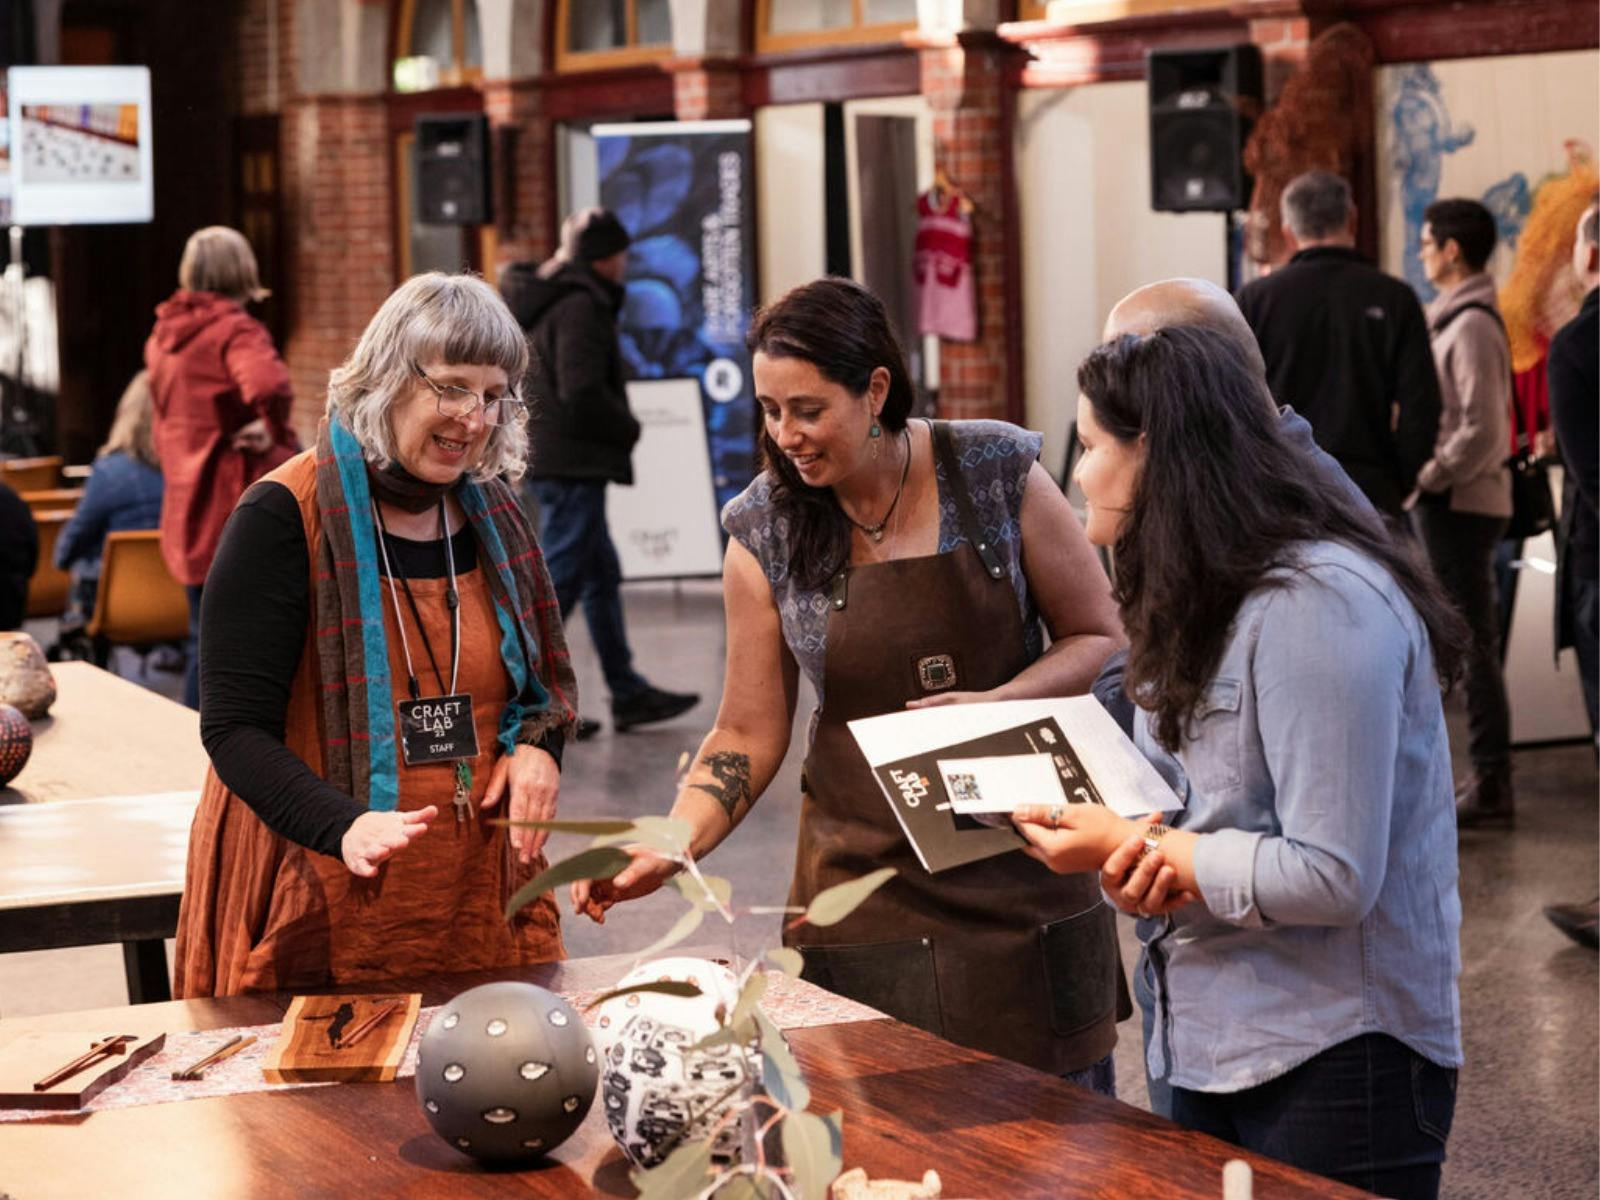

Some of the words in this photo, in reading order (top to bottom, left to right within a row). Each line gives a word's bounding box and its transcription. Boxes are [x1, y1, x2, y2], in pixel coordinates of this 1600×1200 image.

[411, 702, 461, 719] CRAFT
[423, 716, 453, 731] LAB
[429, 742, 455, 754] STAFF
[889, 769, 920, 808] CRAFT
[906, 772, 928, 798] LAB
